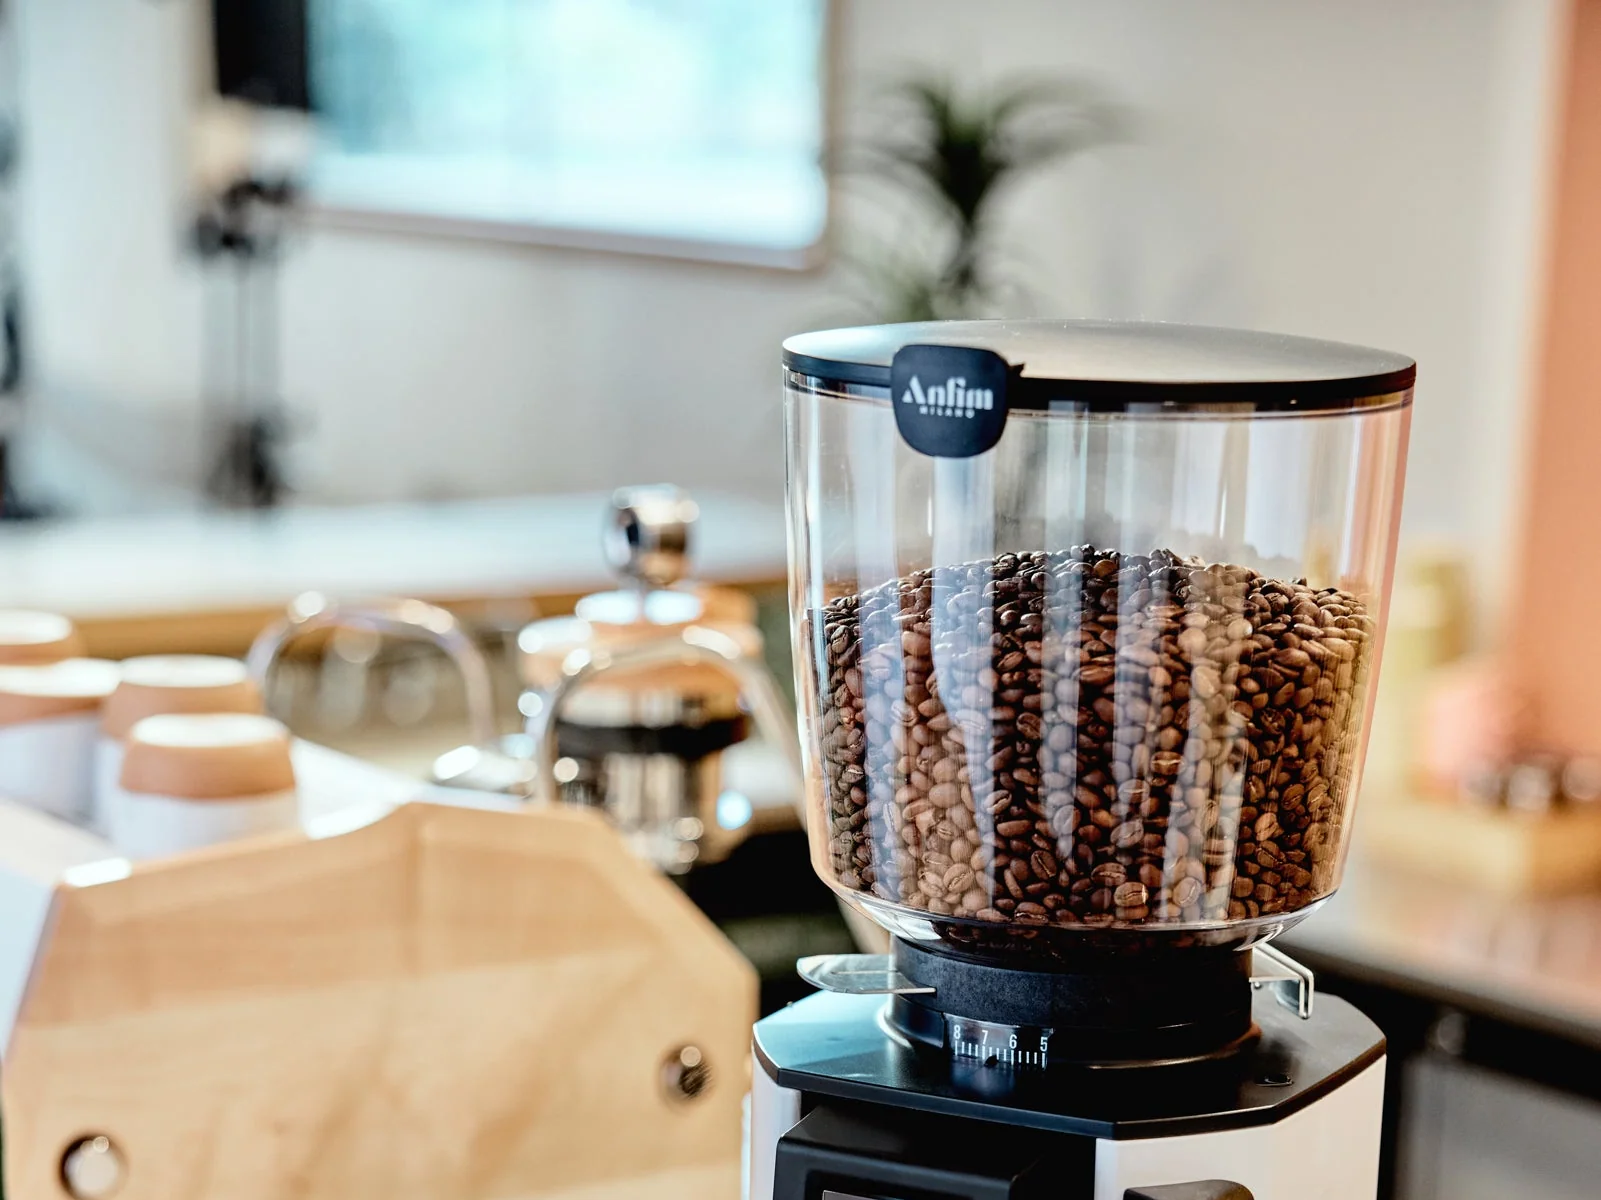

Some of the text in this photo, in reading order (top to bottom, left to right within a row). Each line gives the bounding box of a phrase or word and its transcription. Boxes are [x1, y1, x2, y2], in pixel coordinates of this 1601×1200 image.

[902, 375, 993, 410] Anfim
[919, 405, 975, 419] MILANO
[953, 1025, 1048, 1052] 8 7 6 5
